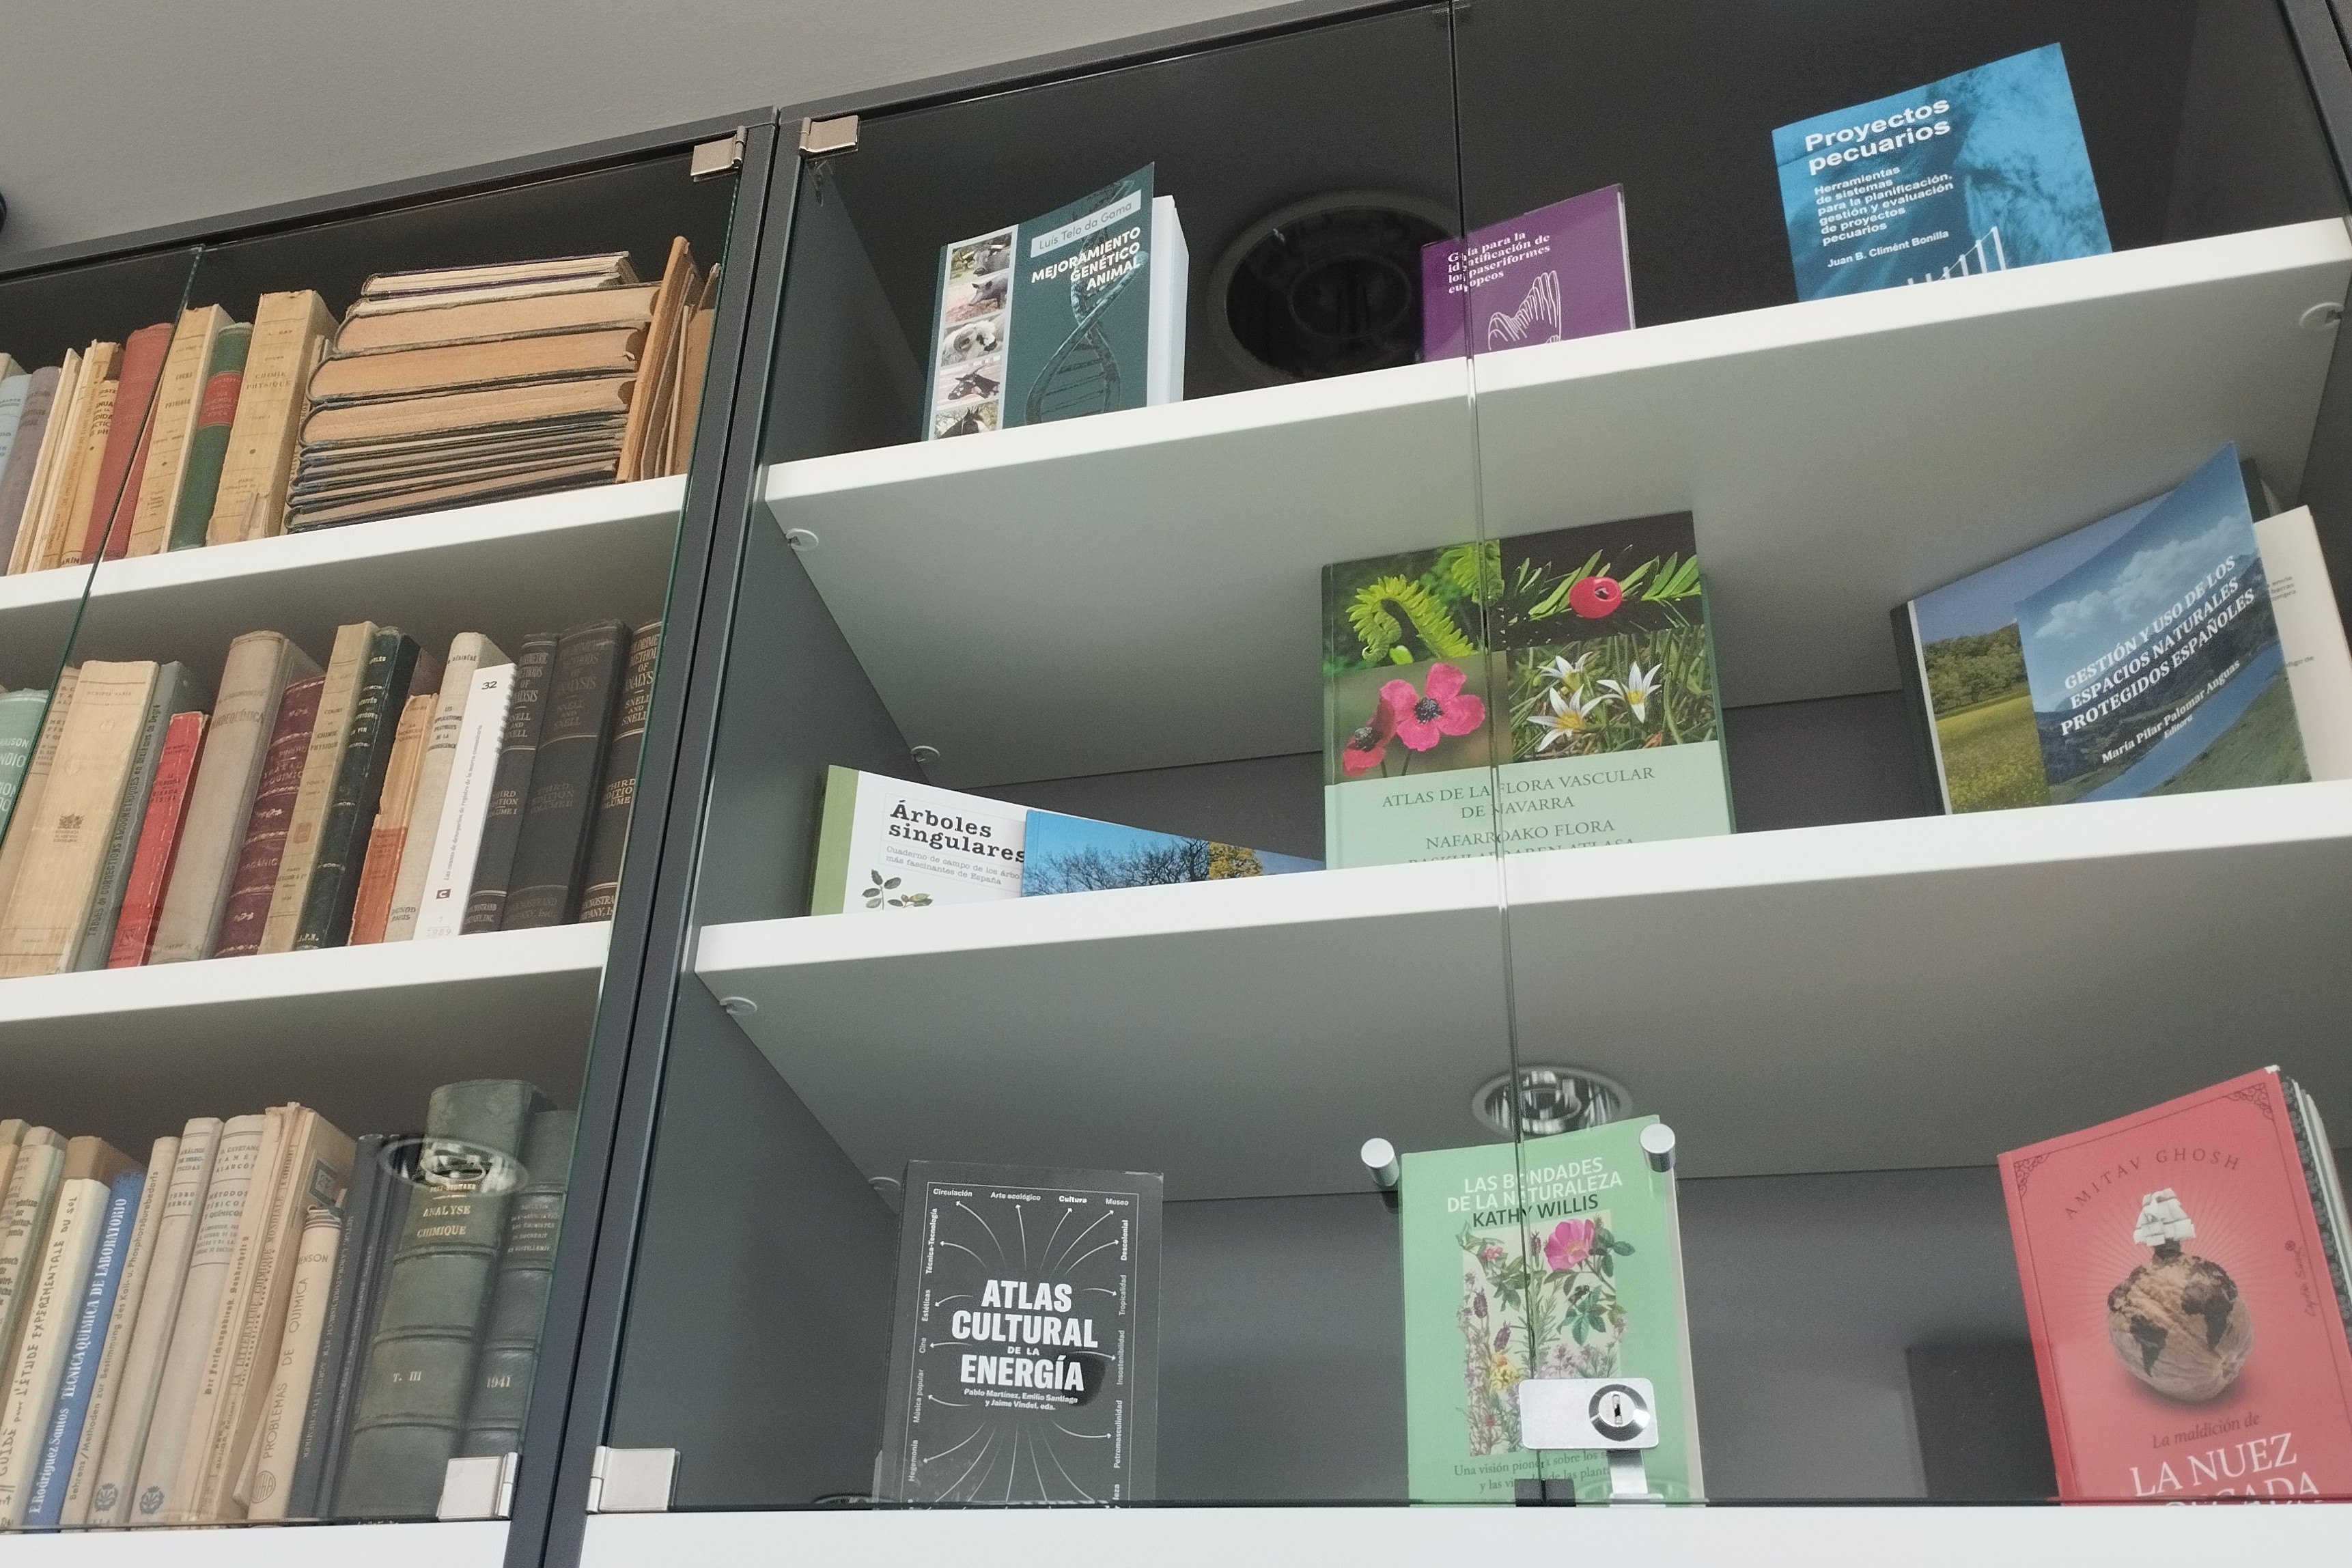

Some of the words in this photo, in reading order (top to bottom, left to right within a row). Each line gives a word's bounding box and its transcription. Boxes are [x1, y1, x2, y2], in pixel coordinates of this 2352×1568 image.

[1805, 98, 1950, 152] Proyectos
[1808, 120, 1951, 176] pecuarios
[1815, 167, 1900, 195] Herramientas
[1816, 195, 1832, 205] de
[1835, 179, 1894, 201] sistemas
[1817, 202, 1847, 216] para
[1850, 197, 1861, 207] la
[1819, 206, 1867, 227] gestión
[1871, 204, 1879, 214] y
[1882, 181, 1954, 208] evaluación
[1039, 235, 1059, 251] Luís
[1061, 226, 1082, 242] Telo
[1084, 217, 1097, 232] da
[1100, 202, 1132, 224] Gama
[1821, 225, 1837, 235] de
[1840, 206, 1906, 232] proyectos
[1822, 223, 1888, 247] pecuarios
[1031, 226, 1140, 283] MEJORAMIENTO
[1482, 236, 1511, 253] para
[1514, 232, 1526, 241] la
[1535, 235, 1550, 244] de
[1828, 255, 1853, 268] Juan
[1856, 251, 1866, 261] B.
[1869, 240, 1909, 257] Climént
[1912, 230, 1949, 247] Bonilla
[1070, 242, 1140, 283] GENÉTICO
[1087, 259, 1141, 291] ANIMAL
[1469, 245, 1551, 279] paseriformes
[247, 380, 291, 390] PHYSIQUE
[2064, 641, 2138, 690] GESTIÓN
[2140, 626, 2151, 643] Y
[2151, 604, 2183, 635] USO
[2184, 587, 2206, 613] DE
[2206, 555, 2237, 591] LOS
[2069, 652, 2151, 710] ESPACIOS
[2152, 576, 2239, 660] NATURALES
[638, 663, 649, 672] OF
[2060, 659, 2170, 736] PROTEGIDOS
[2171, 588, 2255, 669] ESPAÑOLES
[481, 681, 497, 690] 32
[628, 705, 644, 714] AND
[2101, 740, 2135, 764] María
[2136, 721, 2162, 745] Pilar
[2164, 690, 2206, 725] Palomar
[2207, 660, 2241, 695] Anguas
[310, 741, 339, 752] PHYSIQUE
[1382, 791, 1434, 807] ATLAS
[1440, 788, 1464, 801] DE
[1470, 785, 1491, 798] LA
[1558, 767, 1655, 788] VASCULAR
[890, 799, 992, 838] Árboles
[1461, 805, 1485, 818] DE
[888, 822, 1024, 863] singulares
[1554, 820, 1615, 837] FLORA
[886, 845, 927, 860] Cuaderno
[942, 859, 970, 871] campo
[986, 867, 998, 876] los
[886, 855, 904, 865] más
[906, 859, 955, 876] fascinantes
[957, 870, 968, 878] de
[970, 873, 1002, 885] España
[87, 908, 104, 937] TABLES
[933, 1187, 973, 1199] Circulación
[990, 1191, 1005, 1199] Arte
[1007, 1192, 1041, 1202] ecológico
[1464, 1175, 1498, 1195] LAS
[2066, 1156, 2142, 1220] AMITAV
[2156, 1147, 2239, 1171] GHOSH
[60, 1220, 71, 1233] DU
[68, 1196, 77, 1214] SOL
[423, 1205, 471, 1217] ANALYSE
[1059, 1195, 1087, 1205] Cultura
[1106, 1197, 1130, 1206] Museo
[1447, 1194, 1471, 1214] DE
[1475, 1191, 1499, 1210] LA
[1472, 1206, 1532, 1229] KATHY
[1537, 1193, 1599, 1219] WILLIS
[417, 1226, 466, 1238] CHIMIQUE
[925, 1207, 938, 1274] Técnica-Tecnología
[1121, 1220, 1129, 1261] Descolonial
[921, 1289, 932, 1322] Estéticas
[981, 1279, 1072, 1313] ATLAS
[1119, 1274, 1127, 1316] Tropicalidad
[53, 1408, 70, 1445] Santos
[89, 1275, 105, 1296] DE
[97, 1197, 127, 1276] LABORATORIO
[951, 1310, 1099, 1348] CULTURAL
[100, 1324, 122, 1379] Bestimmung
[116, 1303, 125, 1320] des
[1007, 1346, 1021, 1354] DE
[1026, 1347, 1040, 1356] LA
[393, 1373, 403, 1384] T.
[409, 1371, 422, 1382] III
[486, 1375, 511, 1388] 1941
[916, 1369, 925, 1395] popular
[960, 1354, 1084, 1391] ENERGÍA
[263, 1382, 288, 1459] PROBLEMAS
[281, 1347, 294, 1367] DE
[914, 1396, 922, 1423] Música
[964, 1388, 985, 1397] Pablo
[986, 1390, 1021, 1400] Martínez,
[1046, 1394, 1078, 1404] Santiago
[991, 1399, 1012, 1408] Jaime
[1113, 1399, 1123, 1469] Petromasculinidad
[2153, 1435, 2170, 1449] La
[2174, 1418, 2240, 1444] maldición
[2244, 1412, 2259, 1428] de
[908, 1440, 919, 1482] Hegemonía
[1454, 1464, 1476, 1476] Una
[1479, 1462, 1509, 1474] visión
[1553, 1451, 1580, 1466] sobre
[1583, 1448, 1597, 1461] los
[2129, 1461, 2183, 1497] LA
[2187, 1432, 2297, 1486] NUEZ
[1479, 1483, 1486, 1494] y
[1488, 1479, 1502, 1490] las
[1564, 1471, 1578, 1481] las
